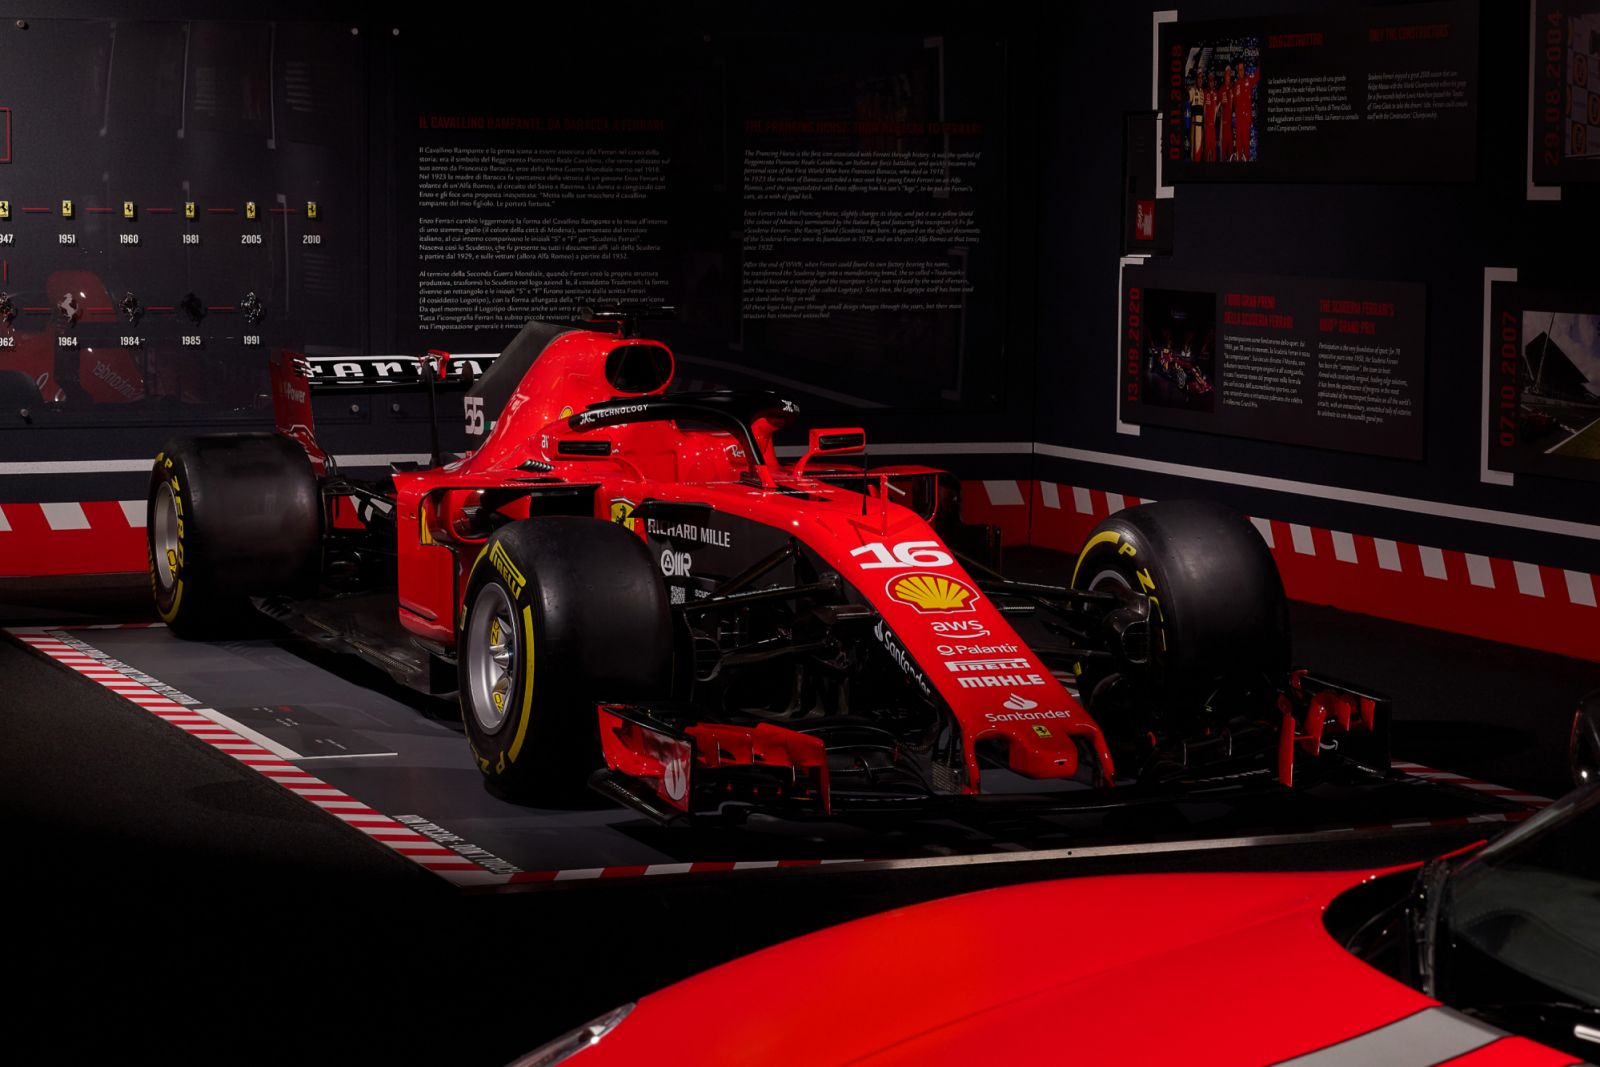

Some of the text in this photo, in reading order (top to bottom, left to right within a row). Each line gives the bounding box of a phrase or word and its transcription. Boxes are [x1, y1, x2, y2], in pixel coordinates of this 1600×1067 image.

[1168, 43, 1184, 161] 02.11.2008
[58, 234, 76, 244] 1951
[120, 234, 138, 244] 1960
[182, 234, 200, 244] 1981
[241, 234, 262, 244] 2005
[302, 234, 320, 244] 2010
[58, 336, 78, 346] 1964
[120, 336, 140, 346] 1984
[182, 336, 201, 346] 1985
[243, 336, 260, 346] 1991
[1500, 310, 1521, 449] 07.10.2007
[463, 396, 485, 436] 55
[596, 404, 649, 418] TECHNOLOGY
[647, 518, 731, 548] RICHARD MILLE
[850, 541, 954, 570] 16
[488, 539, 527, 600] PIRELLI
[930, 620, 984, 632] aws
[957, 643, 1019, 655] Palantir
[884, 630, 931, 697] Santander
[944, 658, 1031, 672] PIRELLI
[956, 674, 1046, 688] MAHLE
[984, 707, 1071, 722] Santander
